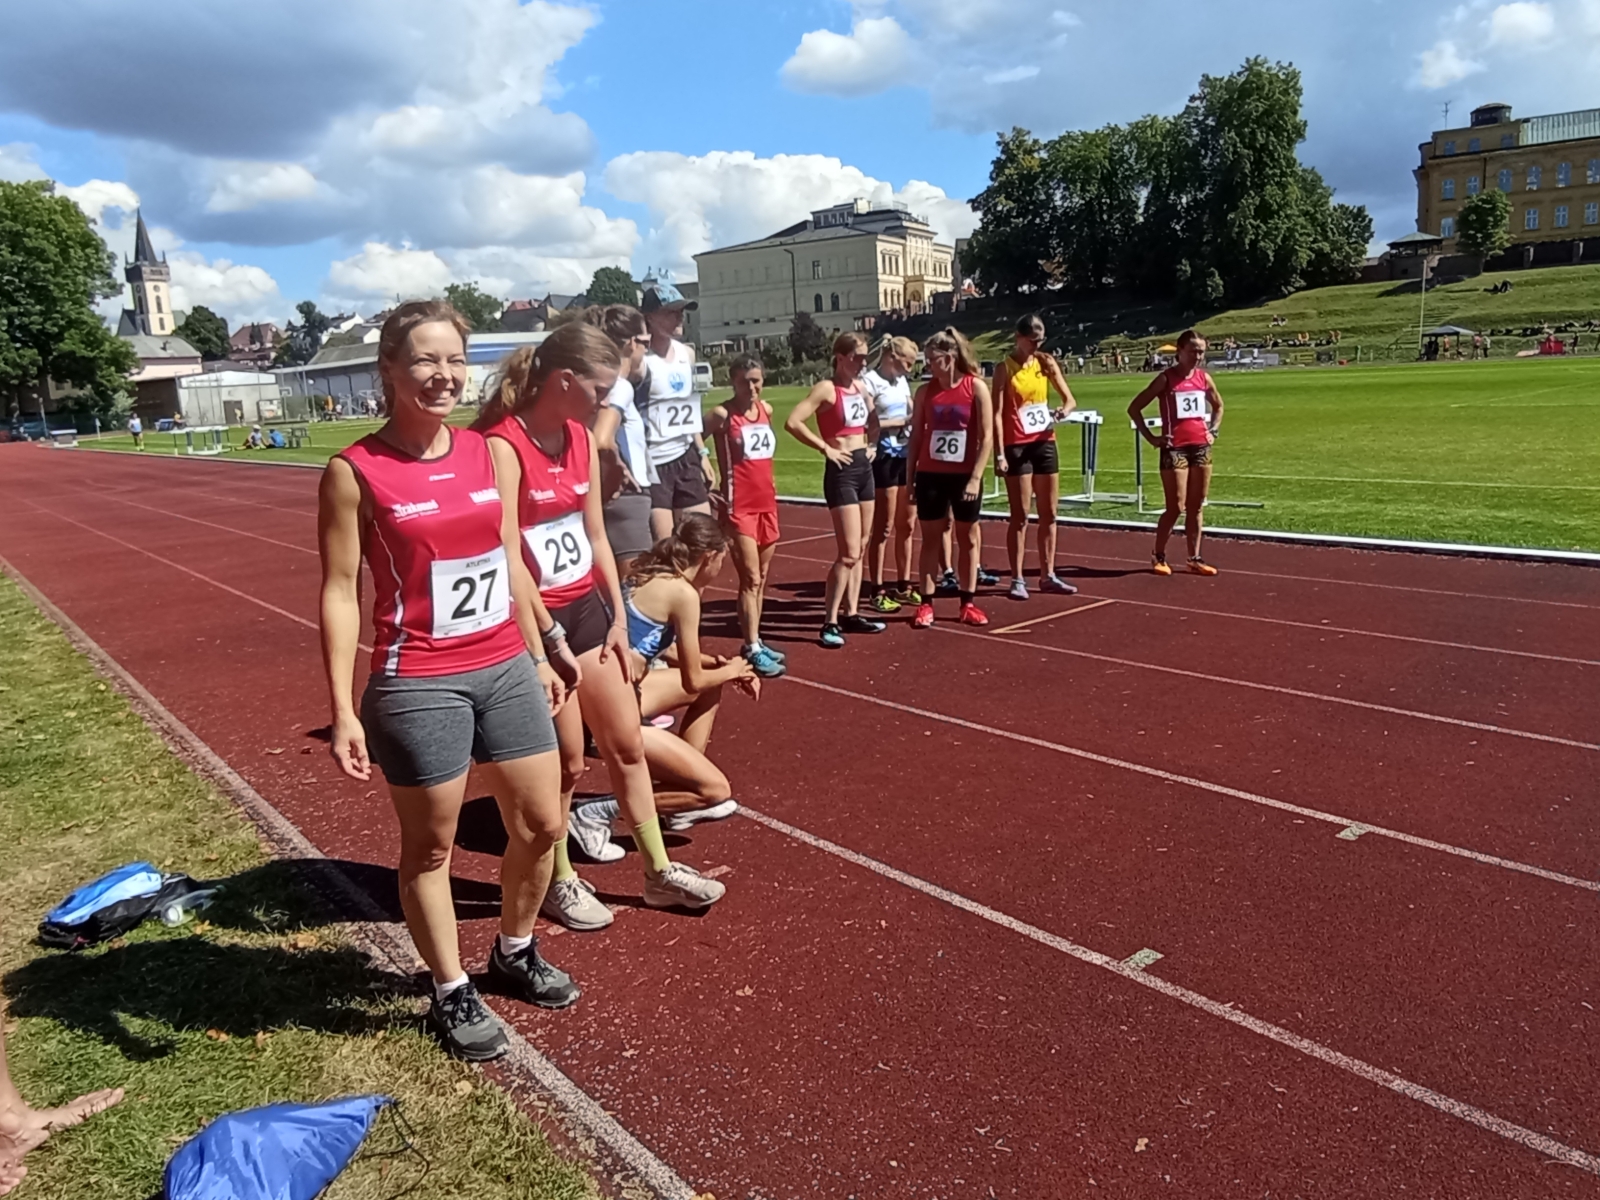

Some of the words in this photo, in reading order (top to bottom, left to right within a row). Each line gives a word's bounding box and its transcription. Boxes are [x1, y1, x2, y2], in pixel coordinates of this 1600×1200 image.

[851, 402, 866, 420] 25
[1182, 397, 1199, 412] 31
[666, 404, 694, 427] 22
[1026, 409, 1046, 426] 33
[750, 433, 771, 452] 24
[934, 436, 959, 455] 26
[544, 531, 581, 575] 29
[450, 567, 498, 621] 27
